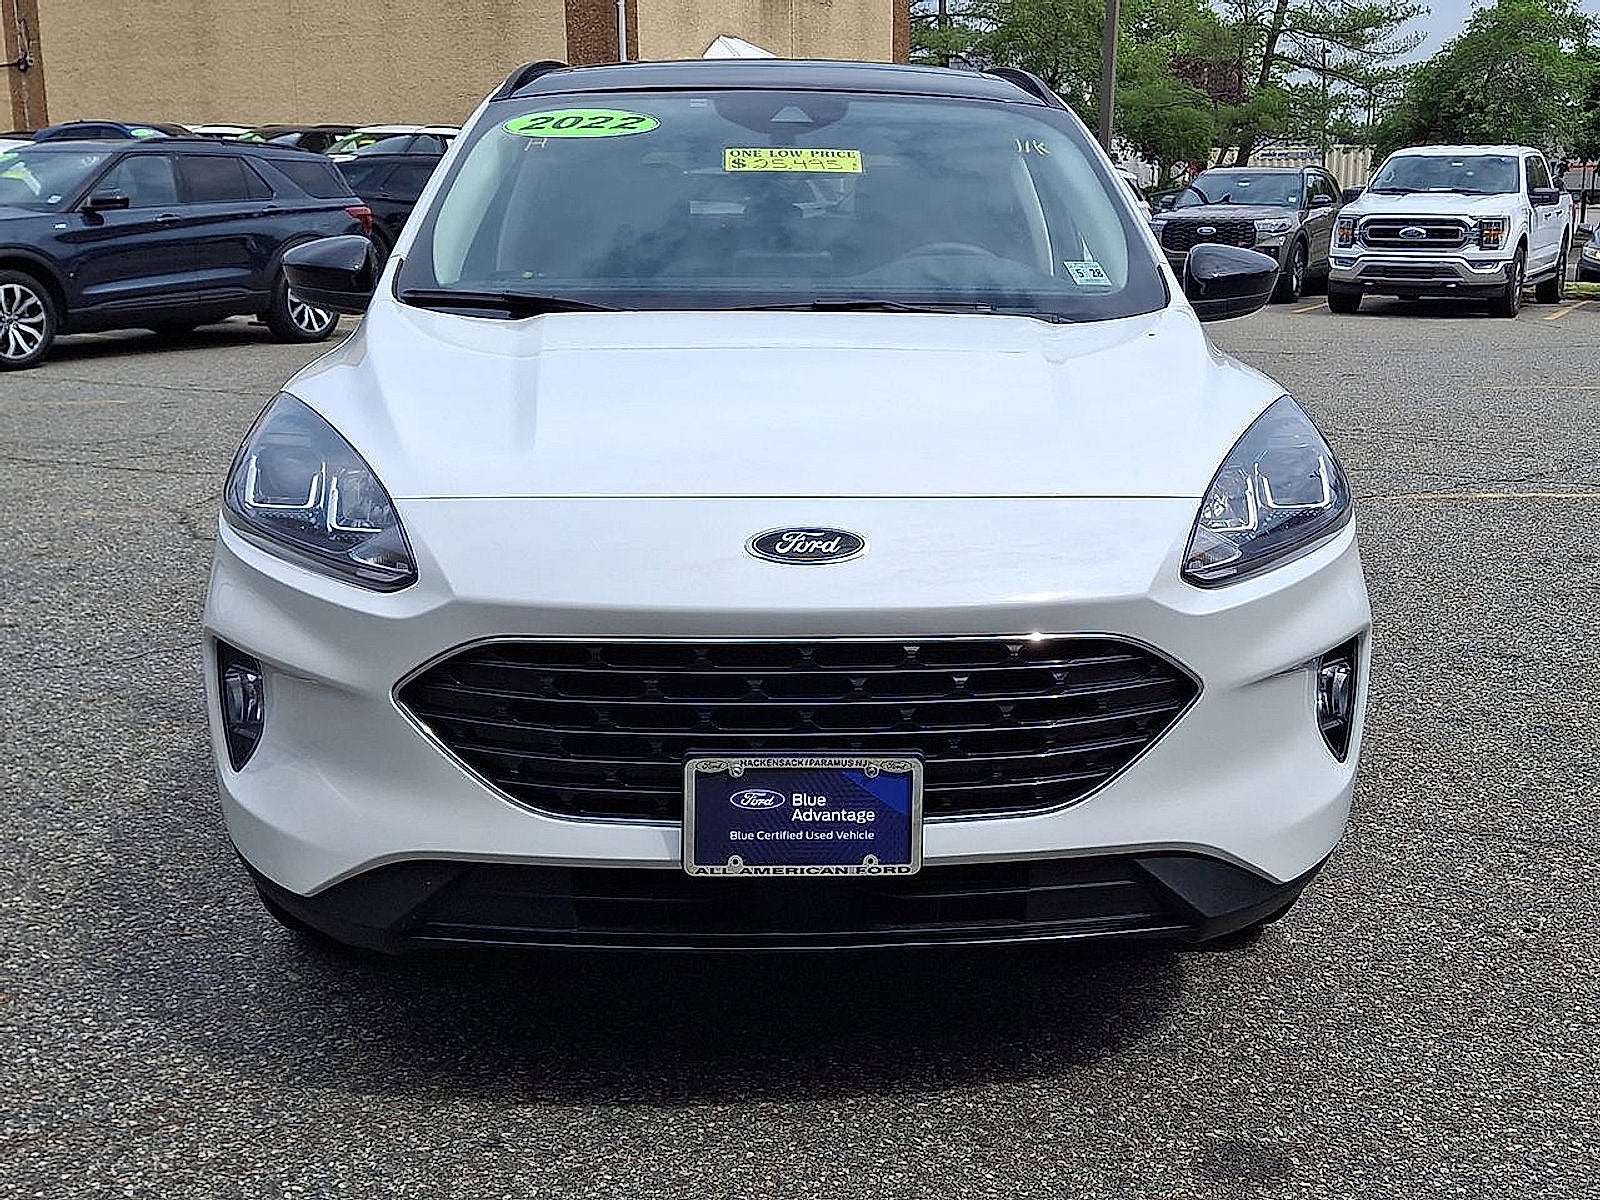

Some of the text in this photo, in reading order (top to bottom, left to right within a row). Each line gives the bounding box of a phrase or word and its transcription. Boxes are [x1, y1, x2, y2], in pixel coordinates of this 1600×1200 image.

[520, 116, 646, 131] 2022
[730, 150, 856, 159] ONE LOW PRICE
[775, 531, 842, 554] Ford
[740, 792, 775, 807] Ford
[792, 793, 827, 806] Blue
[791, 808, 876, 824] Advantage
[729, 830, 875, 841] Blue Certified Used Vehicle
[694, 866, 912, 875] ALL AMERICAN FORD
